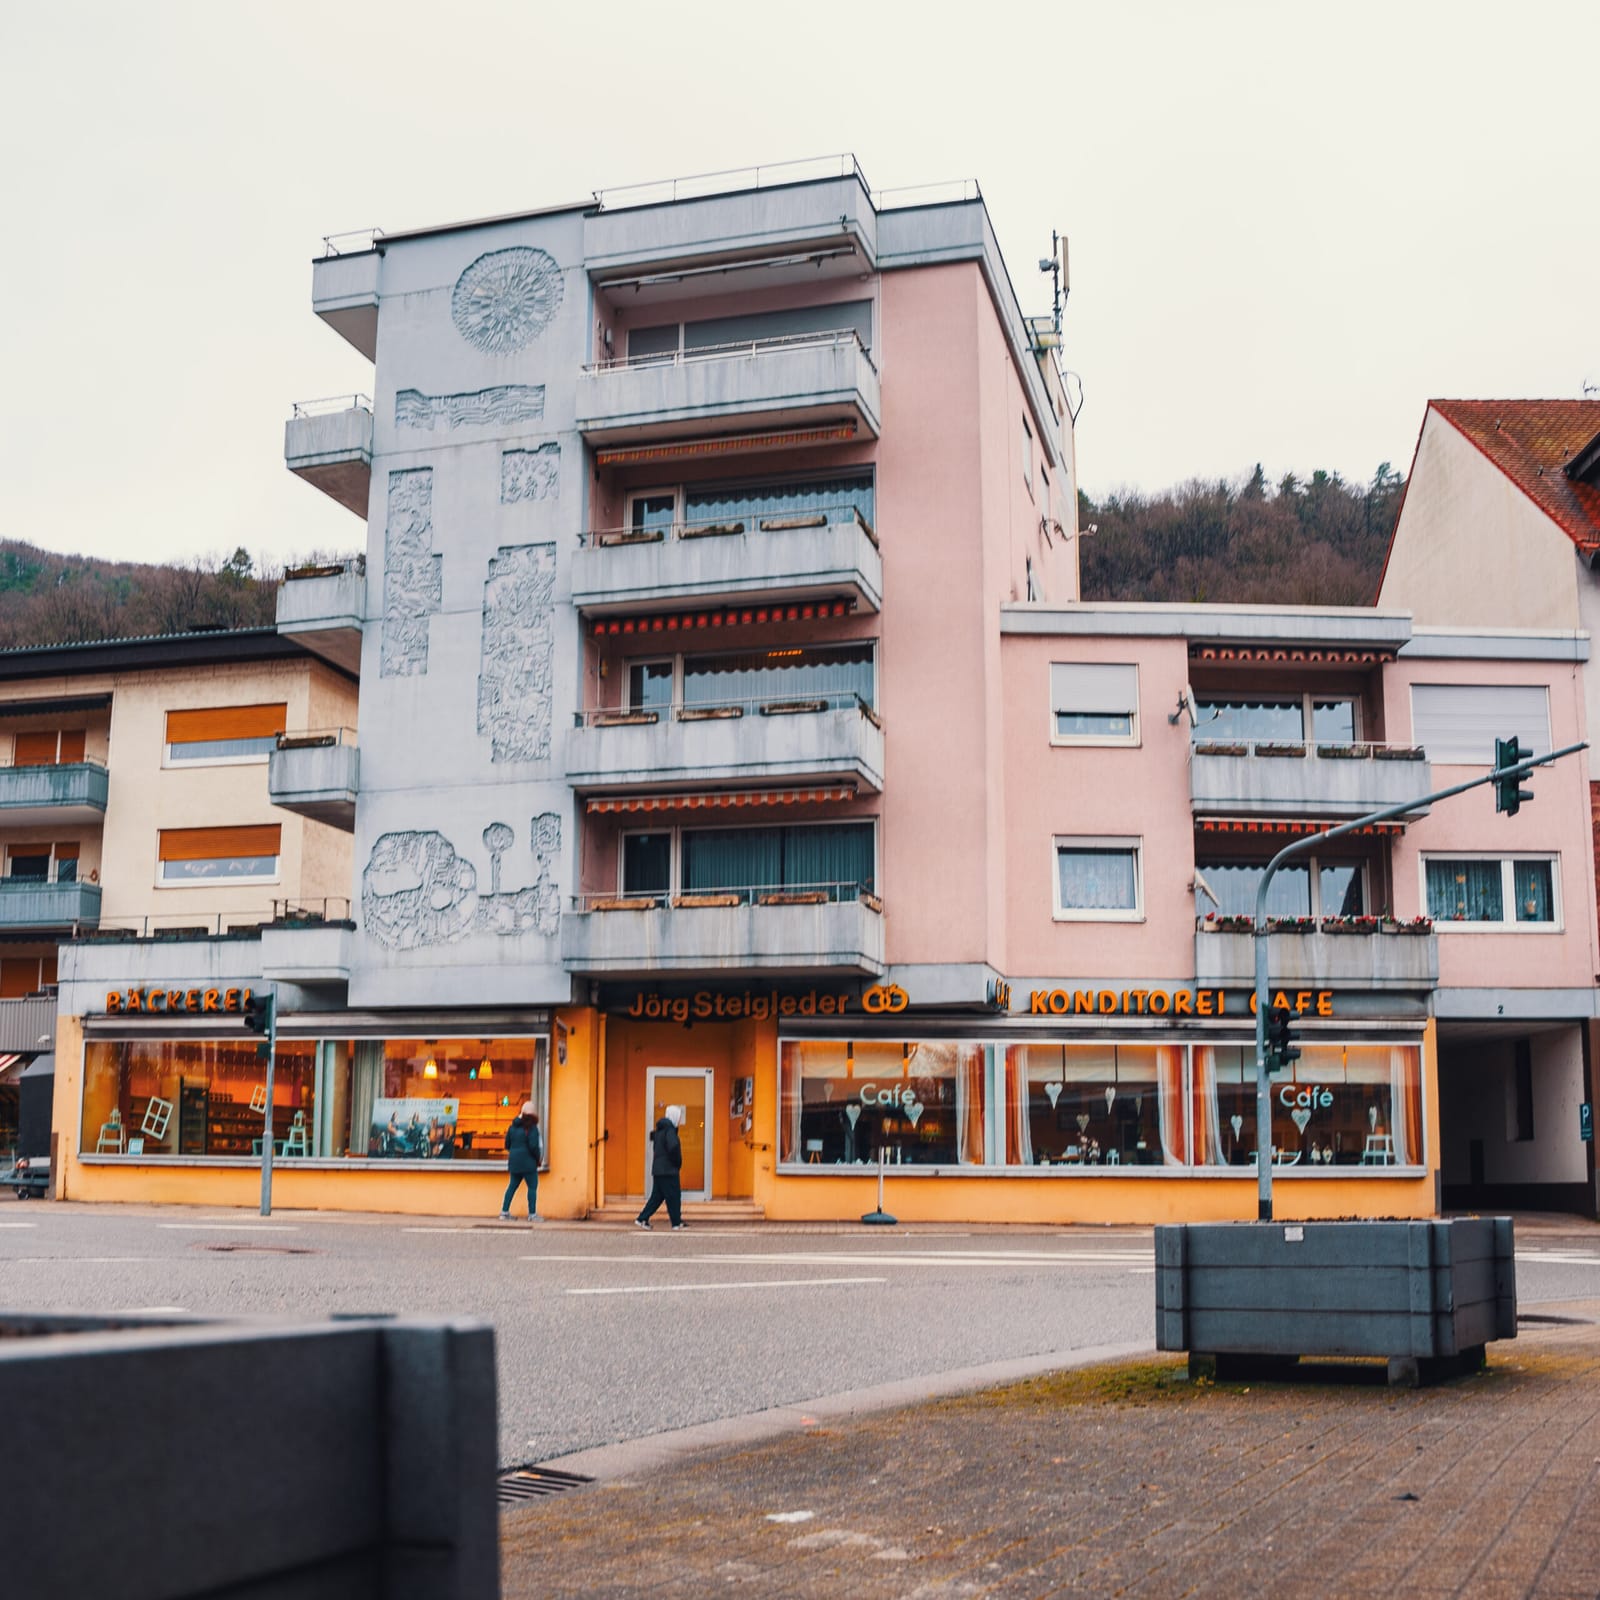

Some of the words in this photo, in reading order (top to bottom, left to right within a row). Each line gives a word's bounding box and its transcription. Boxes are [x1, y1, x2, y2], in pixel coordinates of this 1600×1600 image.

[106, 987, 252, 1014] BÄCKEREI
[629, 992, 689, 1022] Jörg
[694, 990, 849, 1019] Steigleder
[1030, 989, 1225, 1015] KONDITOREI
[1497, 1004, 1504, 1015] 2
[860, 1083, 916, 1107] Café
[1280, 1085, 1334, 1110] Café
